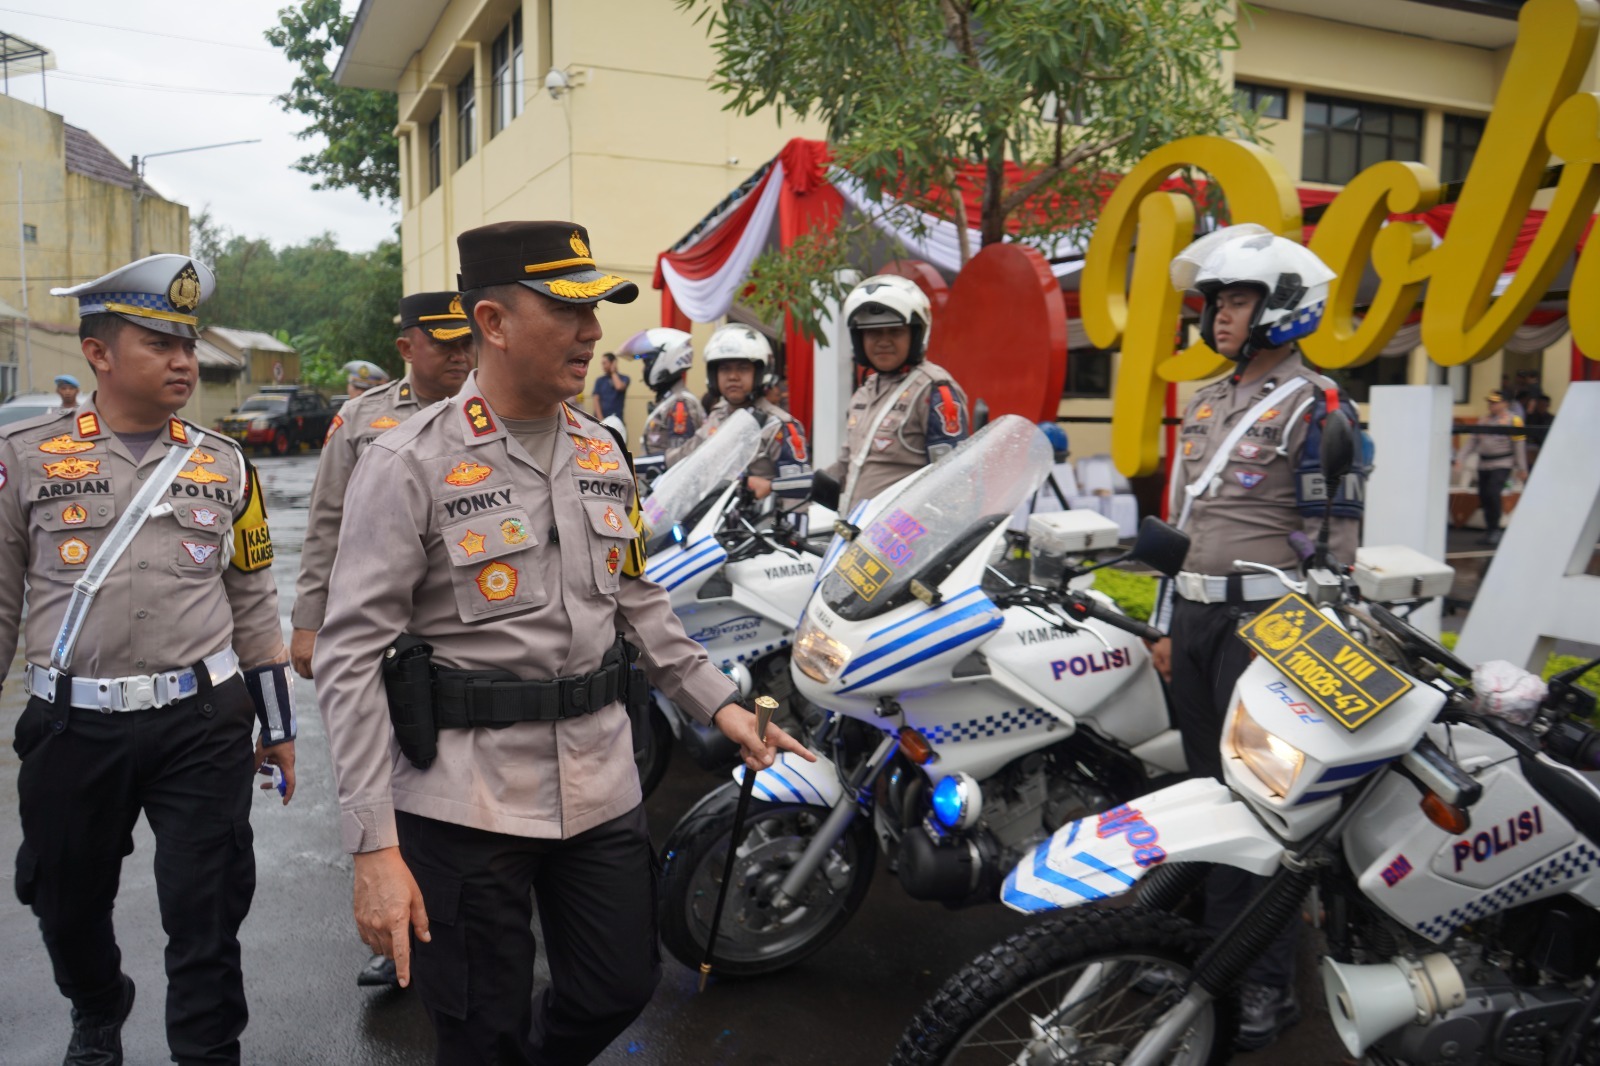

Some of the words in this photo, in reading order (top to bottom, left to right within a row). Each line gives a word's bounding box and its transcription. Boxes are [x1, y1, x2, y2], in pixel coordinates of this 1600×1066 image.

[37, 480, 109, 499] ARDIAN
[171, 483, 233, 504] POLRI
[444, 489, 511, 518] YONKY
[579, 479, 625, 498] POLRI
[865, 521, 915, 569] POLISI
[1050, 647, 1132, 681] POLISI
[1333, 645, 1377, 681] VIII
[1284, 650, 1369, 715] 110026-47
[1453, 805, 1543, 873] POLISI
